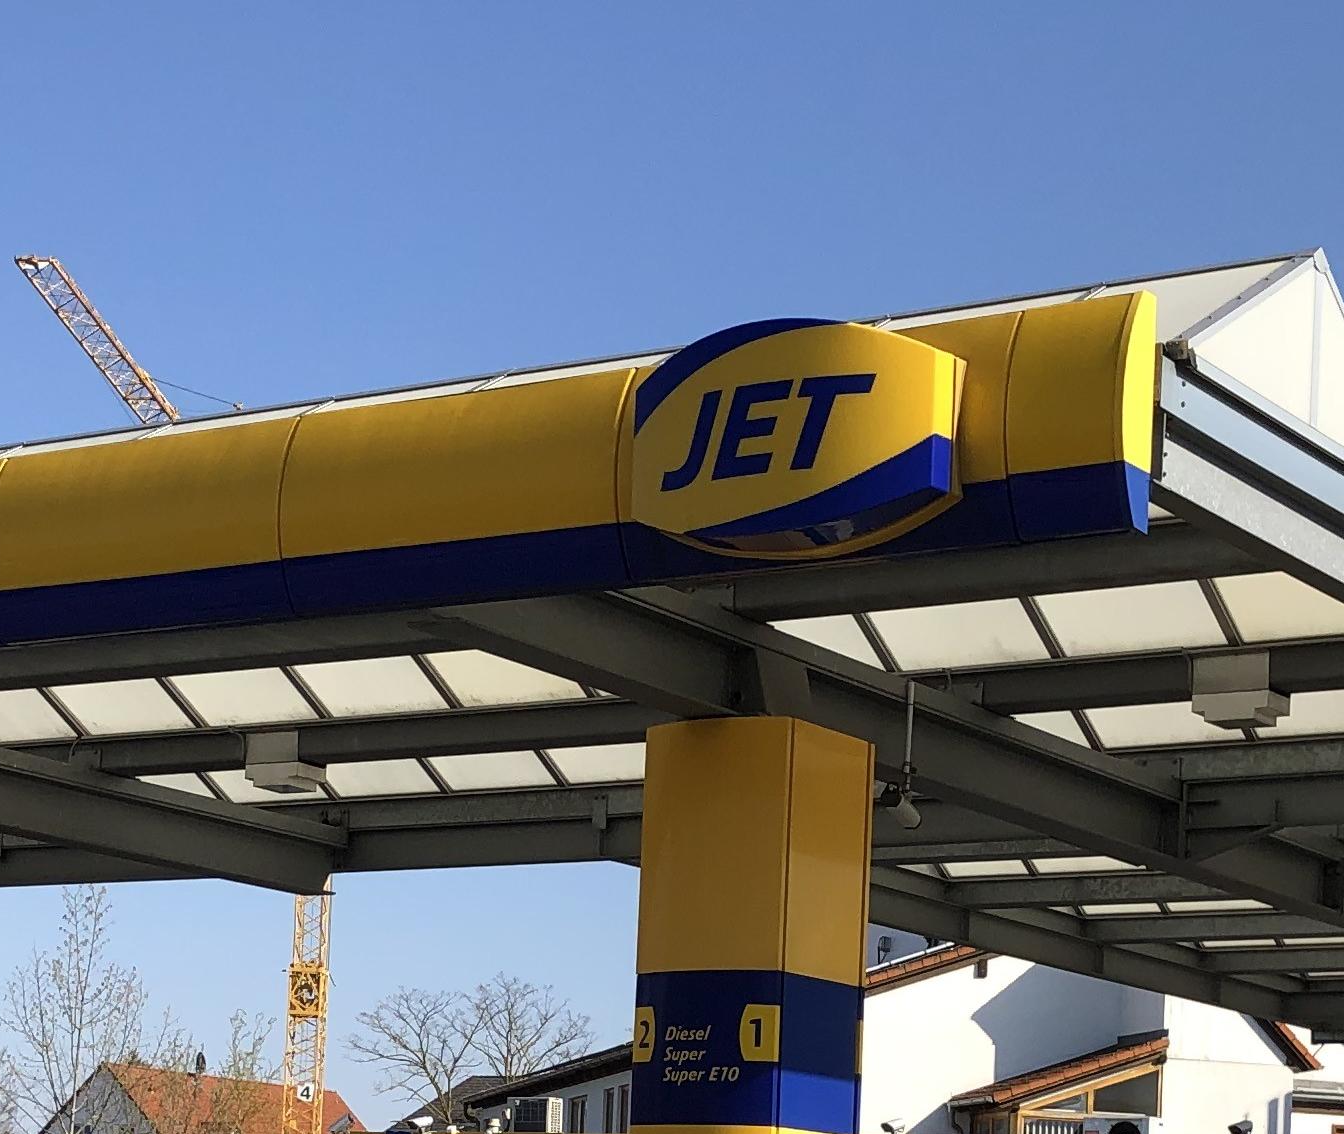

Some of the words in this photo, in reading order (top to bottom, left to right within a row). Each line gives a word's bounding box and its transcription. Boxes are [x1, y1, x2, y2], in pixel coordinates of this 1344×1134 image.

[659, 373, 877, 492] JET
[638, 1020, 650, 1049] 2
[664, 1025, 712, 1041] Diesel
[749, 1018, 762, 1048] 1
[663, 1047, 706, 1065] Super
[662, 1067, 705, 1086] Super
[709, 1067, 740, 1082] E10
